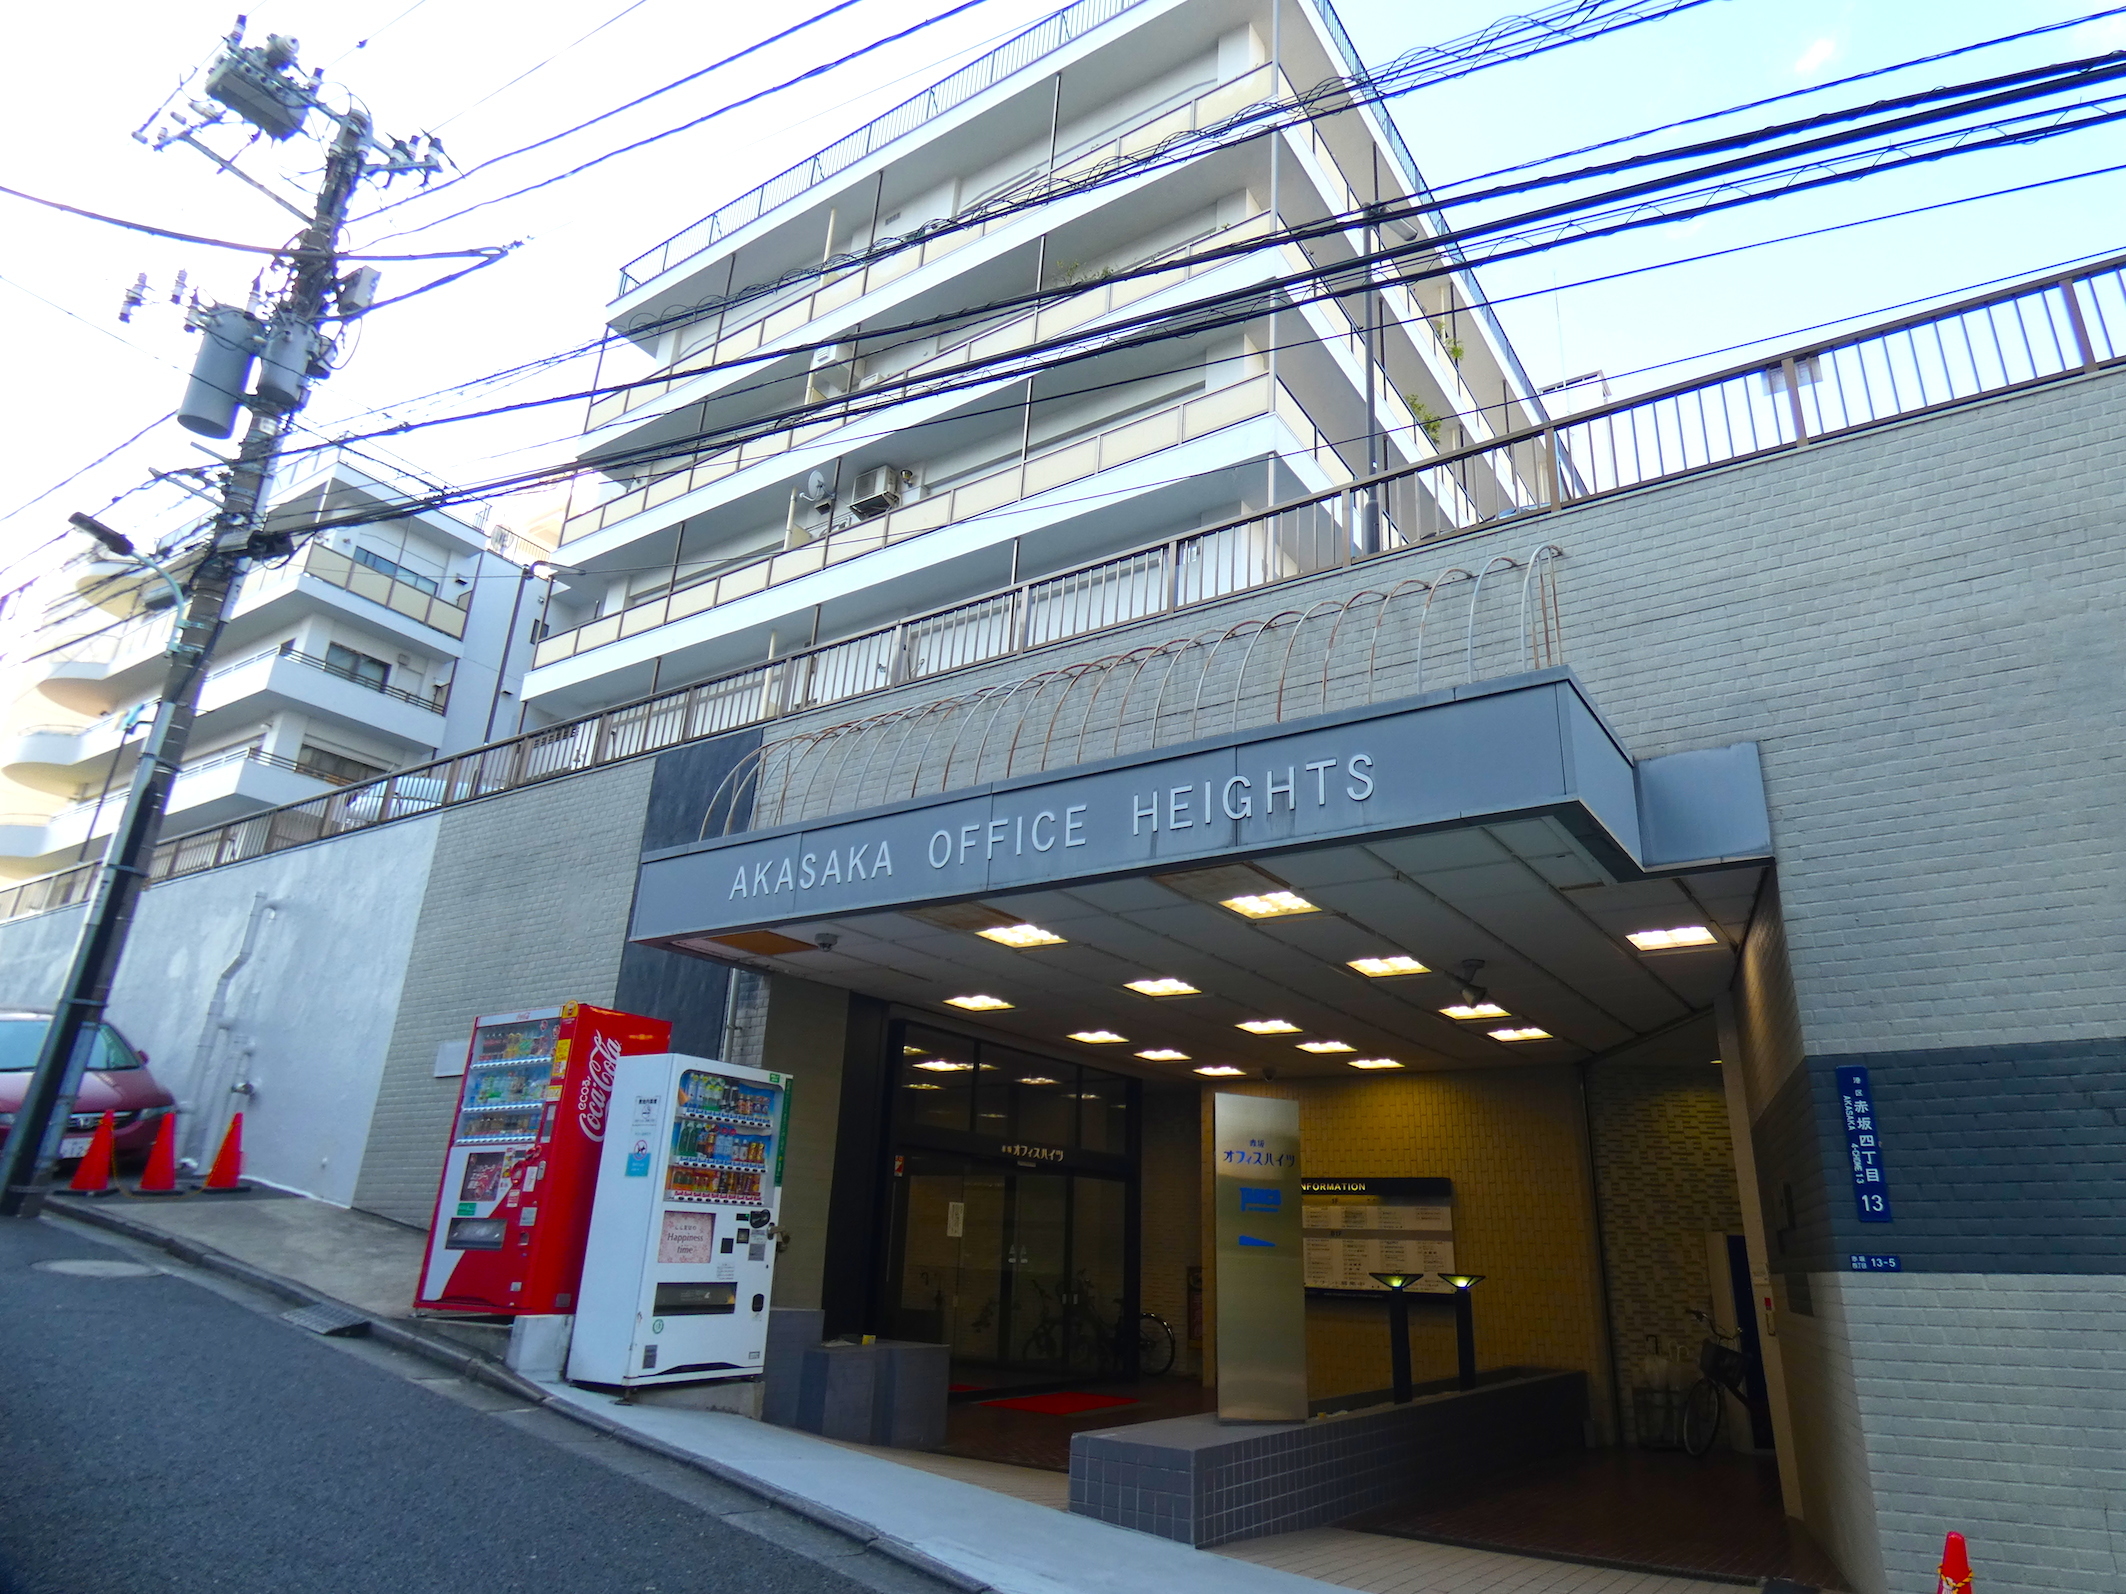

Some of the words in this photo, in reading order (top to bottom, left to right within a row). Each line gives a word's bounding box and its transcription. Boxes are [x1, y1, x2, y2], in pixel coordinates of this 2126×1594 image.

[728, 840, 893, 901] AKASAKA
[928, 804, 1088, 869] OFFICE
[1132, 753, 1375, 836] HEIGHTS
[1842, 1094, 1857, 1131] AKASAKA
[1855, 1173, 1865, 1184] 13
[1854, 1099, 1880, 1183] 赤坂四丁目
[1001, 1144, 1064, 1162] オフィスハイツ
[1223, 1150, 1295, 1167] オフィスハイツ
[1300, 1182, 1366, 1191] NFORMATION
[1861, 1194, 1884, 1212] 13
[667, 1232, 704, 1243] Happiness
[676, 1244, 694, 1253] time
[1870, 1257, 1896, 1268] 13-5
